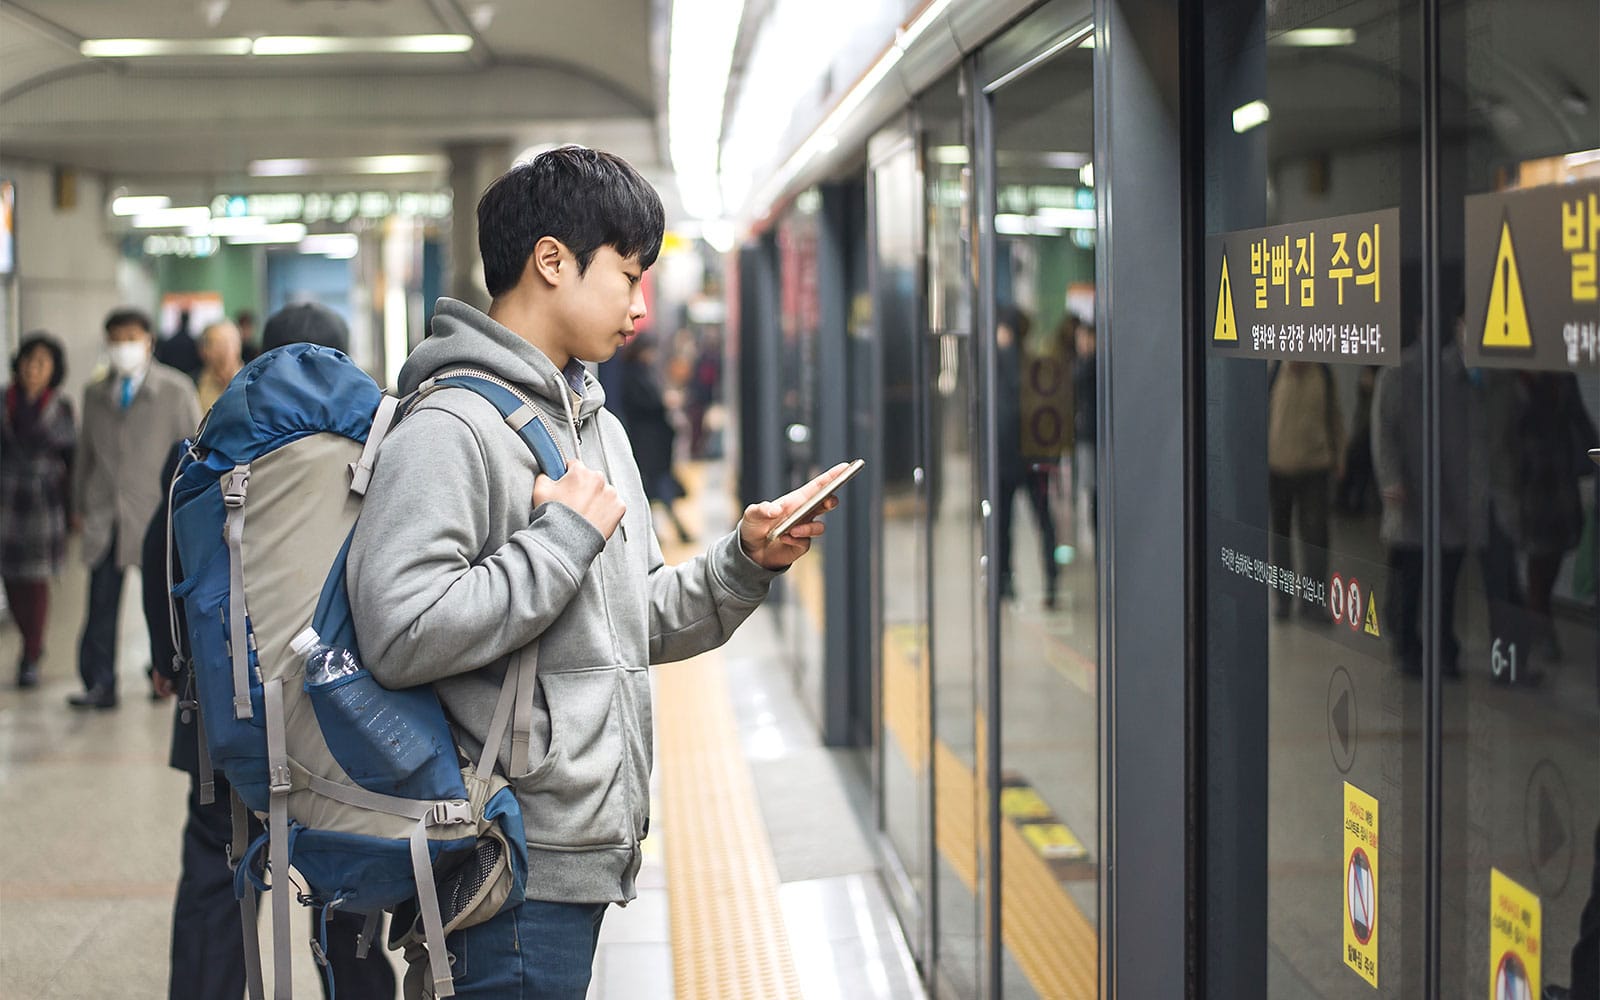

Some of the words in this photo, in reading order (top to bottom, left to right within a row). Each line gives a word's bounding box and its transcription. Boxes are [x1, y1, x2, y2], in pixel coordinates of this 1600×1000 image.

[1251, 232, 1315, 309] 발빠짐
[1328, 223, 1380, 306] 주의
[1251, 323, 1276, 351] 열차와
[1279, 323, 1304, 353] 승강장
[1308, 323, 1337, 353] 사이가
[1340, 323, 1385, 354] 넓습니다.
[1563, 320, 1600, 364] 열차
[1235, 551, 1254, 579] 승하차는
[1254, 558, 1278, 589] 안전사고를
[1279, 567, 1295, 596] 유발할
[1295, 573, 1302, 598] 수
[1302, 576, 1327, 608] 있습니다.
[1491, 637, 1516, 682] 6-1
